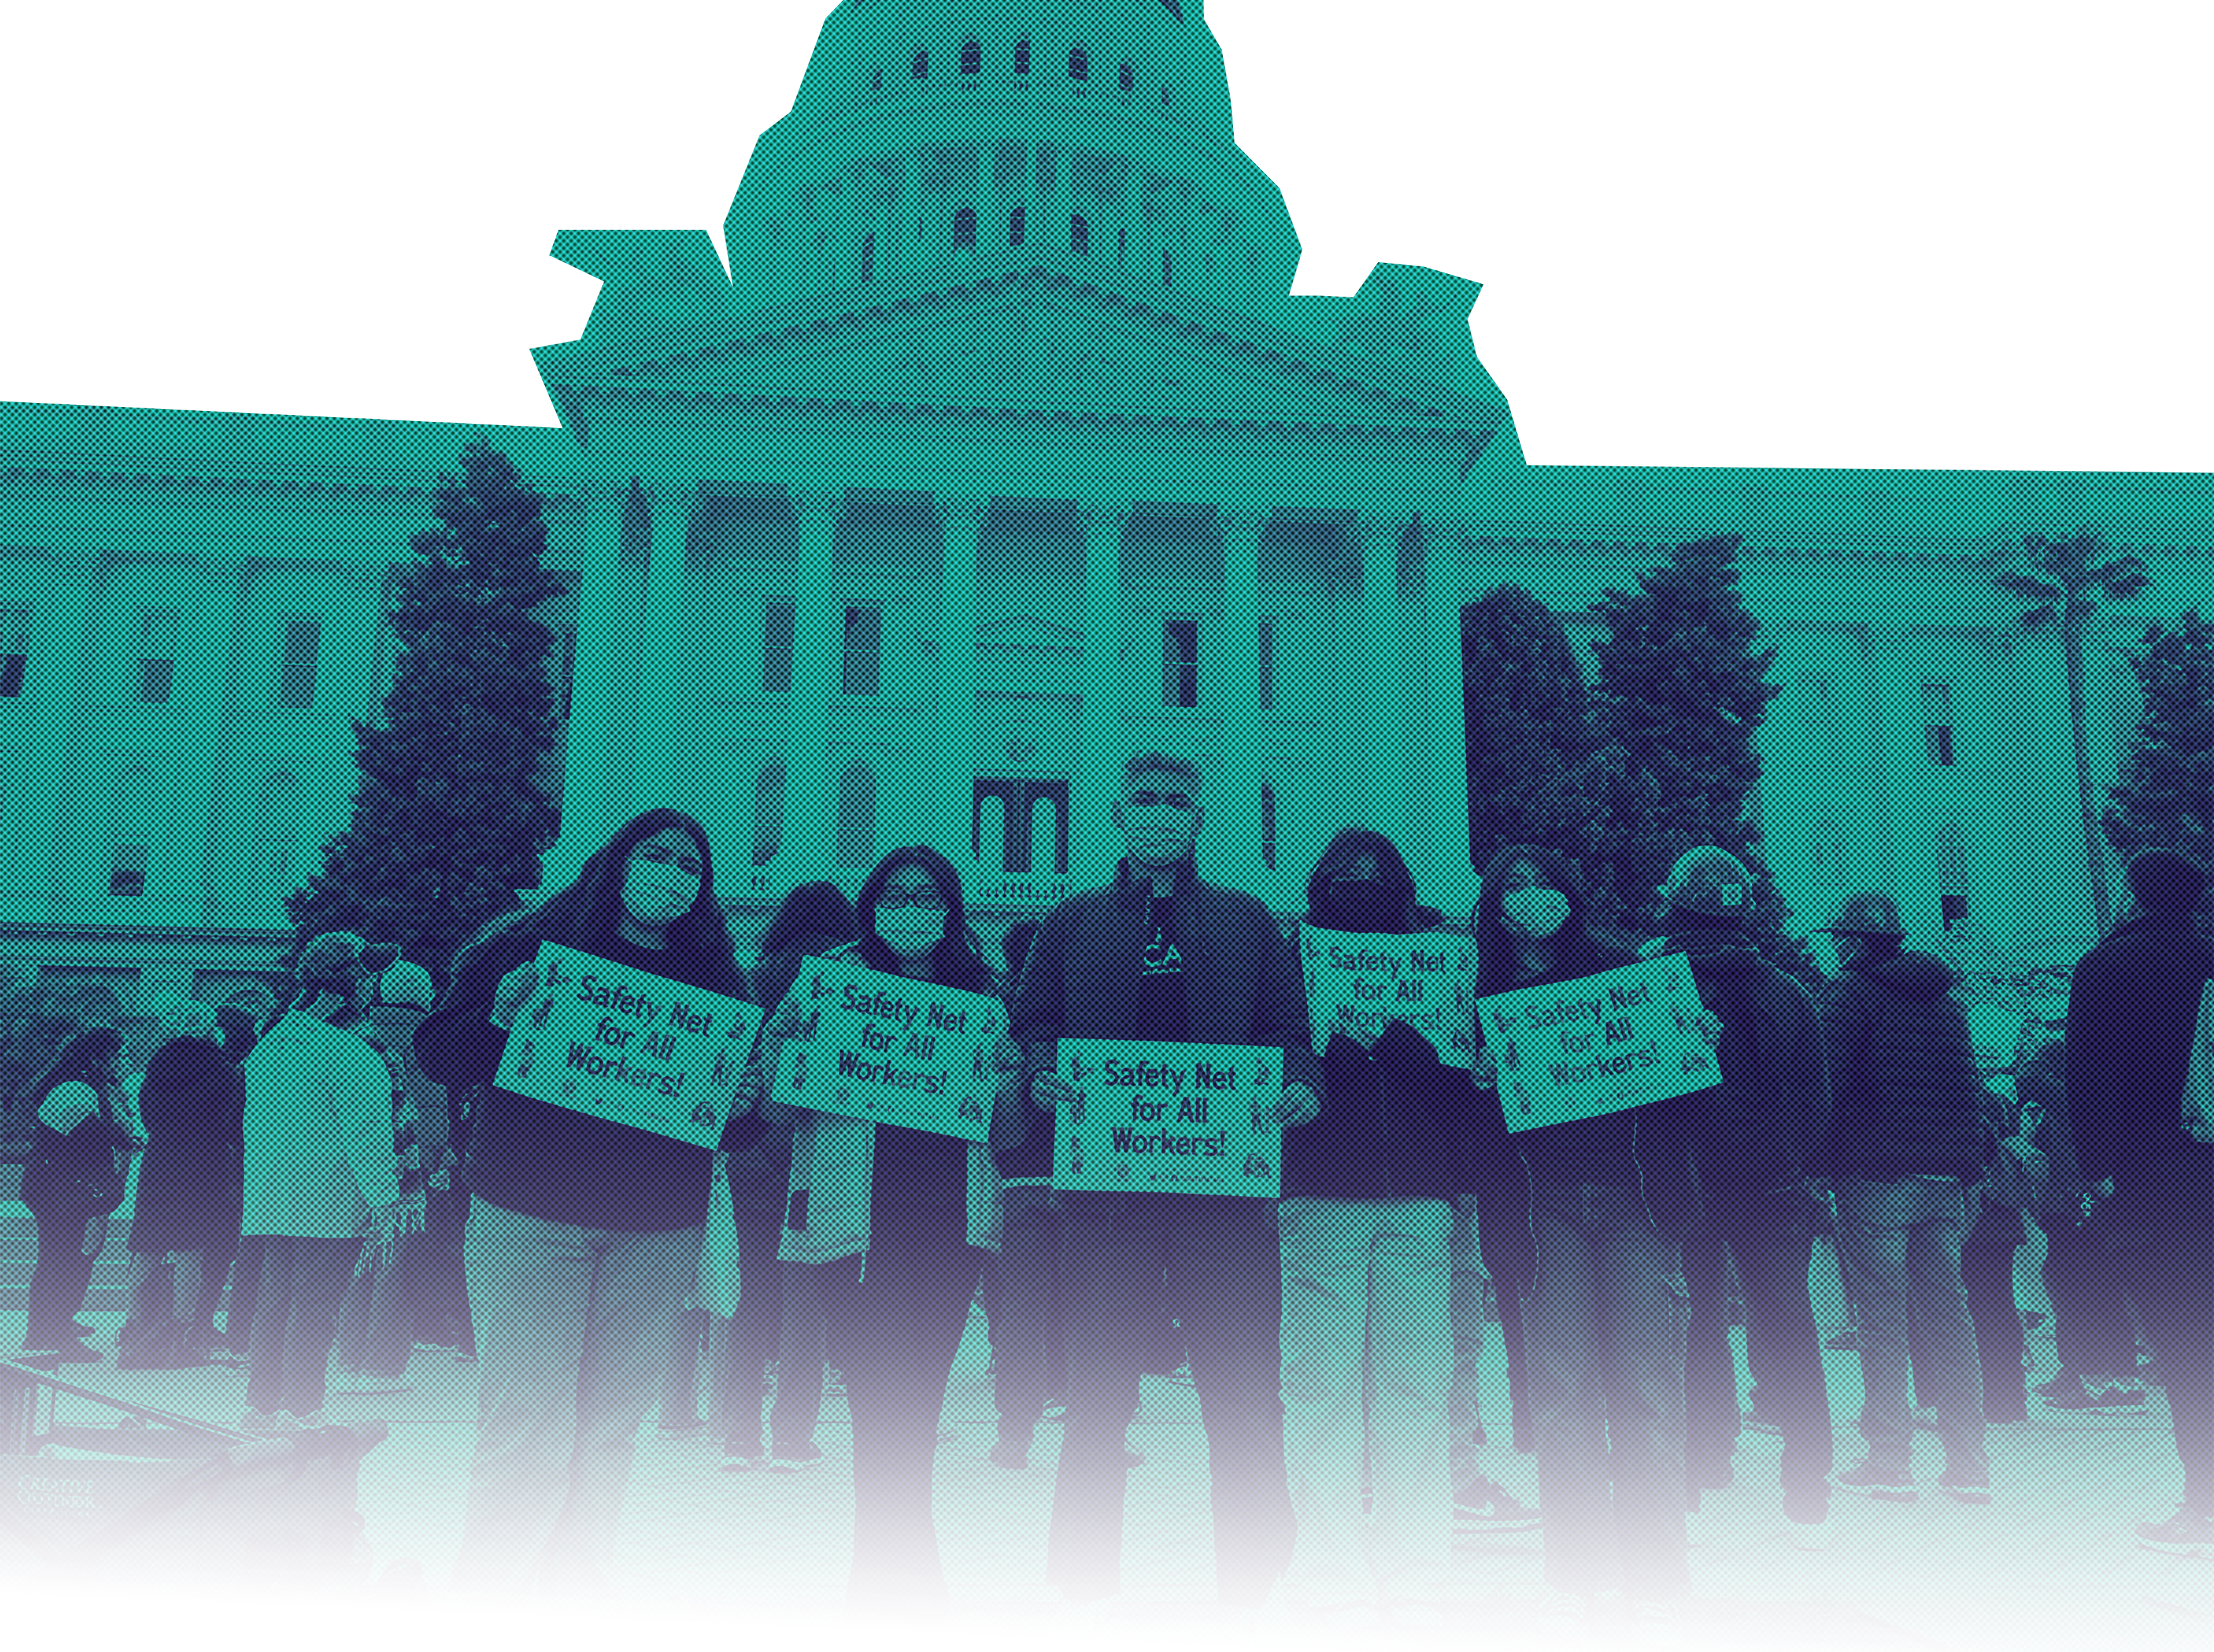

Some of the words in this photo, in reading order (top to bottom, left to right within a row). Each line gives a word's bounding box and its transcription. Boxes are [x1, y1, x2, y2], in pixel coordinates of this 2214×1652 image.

[1144, 943, 1182, 967] CA
[1328, 946, 1403, 981] Safety
[1411, 949, 1446, 975] Net
[577, 975, 662, 1028] Safety
[668, 1001, 713, 1038] Net
[1353, 977, 1388, 1000] for
[1395, 979, 1424, 1002] All
[1524, 998, 1602, 1030] Safety
[1608, 981, 1653, 1012] Net
[841, 984, 920, 1030] Safety
[927, 1001, 967, 1035] Net
[595, 1016, 636, 1049] for
[639, 1030, 677, 1061] All
[861, 1022, 897, 1053] for
[902, 1032, 936, 1061] All
[1560, 1030, 1595, 1055] for
[1605, 1016, 1635, 1046] All
[566, 1041, 686, 1098] Workers!
[838, 1049, 948, 1095] Workers!
[1103, 1059, 1186, 1098] Safety
[1195, 1062, 1237, 1091] Net
[1548, 1040, 1661, 1087] Workers!
[1130, 1094, 1169, 1122] for
[1177, 1096, 1208, 1123] All
[1112, 1126, 1226, 1156] Workers!
[17, 1474, 95, 1494] CREATIVE
